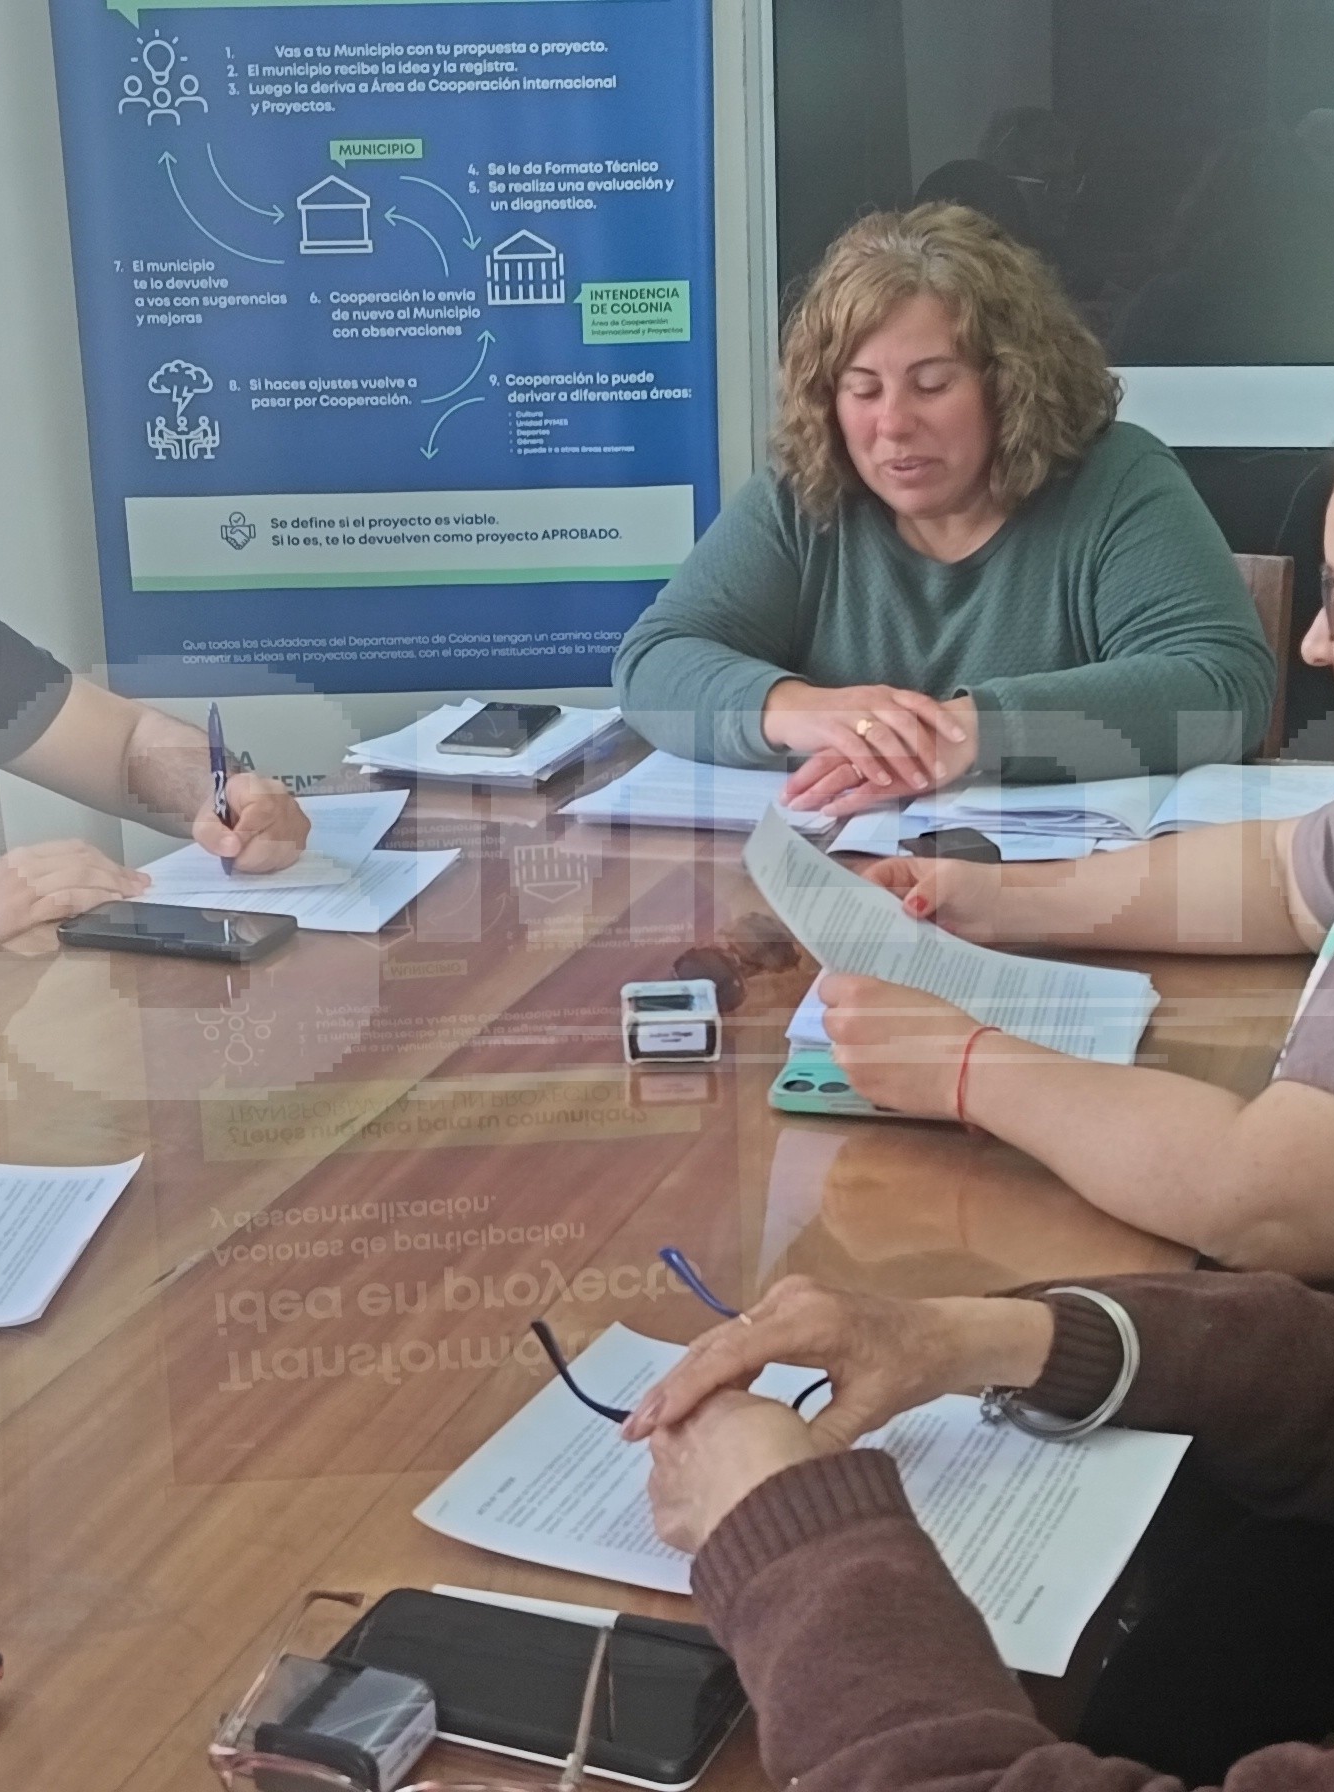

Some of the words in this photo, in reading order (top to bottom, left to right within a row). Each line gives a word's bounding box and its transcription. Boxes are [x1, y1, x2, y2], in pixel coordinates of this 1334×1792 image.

[225, 46, 234, 58] 1.
[274, 45, 301, 58] Vas
[303, 46, 313, 57] a
[315, 45, 331, 57] tu
[333, 42, 404, 59] Municipio
[406, 44, 434, 55] con
[435, 43, 450, 55] tu
[453, 41, 526, 57] propuesta
[529, 42, 539, 53] o
[541, 40, 608, 56] proyecto.
[226, 64, 238, 77] 2.
[247, 63, 259, 77] El
[262, 62, 332, 78] municipio
[334, 61, 379, 75] recibe
[381, 61, 395, 74] la
[398, 60, 430, 74] idea
[431, 62, 441, 76] y
[443, 59, 457, 73] la
[459, 58, 518, 75] registra.
[228, 82, 239, 95] 3.
[248, 83, 292, 97] Luego
[294, 81, 308, 94] la
[310, 79, 355, 94] deriva
[358, 82, 368, 93] a
[370, 76, 404, 93] Área
[407, 78, 426, 92] de
[427, 76, 520, 94] Cooperación
[250, 102, 259, 116] y
[261, 100, 335, 115] Proyectos.
[339, 142, 415, 156] MUNICIPIO
[467, 163, 479, 175] 4.
[487, 162, 505, 175] Se
[507, 161, 520, 175] le
[522, 161, 542, 174] da
[544, 161, 603, 174] Formato
[604, 158, 658, 173] Técnico
[468, 180, 479, 193] 5.
[488, 180, 506, 193] Se
[508, 178, 555, 193] realiza
[557, 181, 584, 192] una
[587, 176, 663, 191] evaluación
[665, 178, 674, 192] y
[490, 200, 508, 211] un
[113, 260, 123, 272] 7.
[132, 259, 144, 272] El
[146, 258, 215, 274] municipio
[133, 278, 147, 289] te
[149, 277, 163, 289] lo
[165, 275, 228, 289] devuelve
[134, 296, 144, 307] a
[146, 296, 171, 307] vos
[172, 296, 199, 307] con
[201, 291, 287, 308] sugerencias
[309, 291, 321, 304] 6.
[329, 289, 420, 306] Cooperación
[422, 288, 435, 302] lo
[437, 287, 475, 301] envía
[590, 287, 679, 300] INTENDENCIA
[331, 308, 349, 321] de
[352, 309, 394, 320] nuevo
[396, 306, 410, 319] al
[413, 305, 480, 321] Municipio
[590, 303, 607, 314] DE
[610, 301, 672, 314] COLONIA
[135, 314, 144, 327] y
[146, 311, 202, 327] mejoras
[332, 327, 359, 338] con
[361, 323, 462, 337] observaciones
[229, 379, 240, 391] 8.
[249, 377, 262, 391] Si
[264, 377, 306, 390] haces
[308, 376, 358, 392] ajustes
[359, 375, 405, 389] vuelve
[407, 377, 417, 388] a
[489, 374, 500, 386] 9.
[505, 371, 593, 388] Cooperación
[595, 371, 609, 384] lo
[611, 369, 654, 387] puede
[251, 397, 291, 411] pasar
[293, 396, 317, 410] por
[319, 392, 412, 409] Cooperación.
[507, 389, 556, 403] derivar
[557, 391, 567, 401] a
[649, 386, 692, 399] áreas:
[270, 517, 287, 529] Se
[290, 516, 335, 528] define
[338, 516, 349, 528] si
[352, 516, 365, 527] el
[368, 516, 431, 530] proyecto
[434, 516, 450, 525] es
[453, 513, 498, 525] viable.
[271, 534, 284, 546] Si
[287, 534, 300, 546] lo
[302, 536, 322, 546] es,
[325, 535, 339, 545] te
[342, 533, 355, 545] lo
[358, 532, 430, 544] devuelven
[433, 533, 473, 543] como
[475, 530, 538, 544] proyecto
[541, 527, 622, 540] APROBADO.
